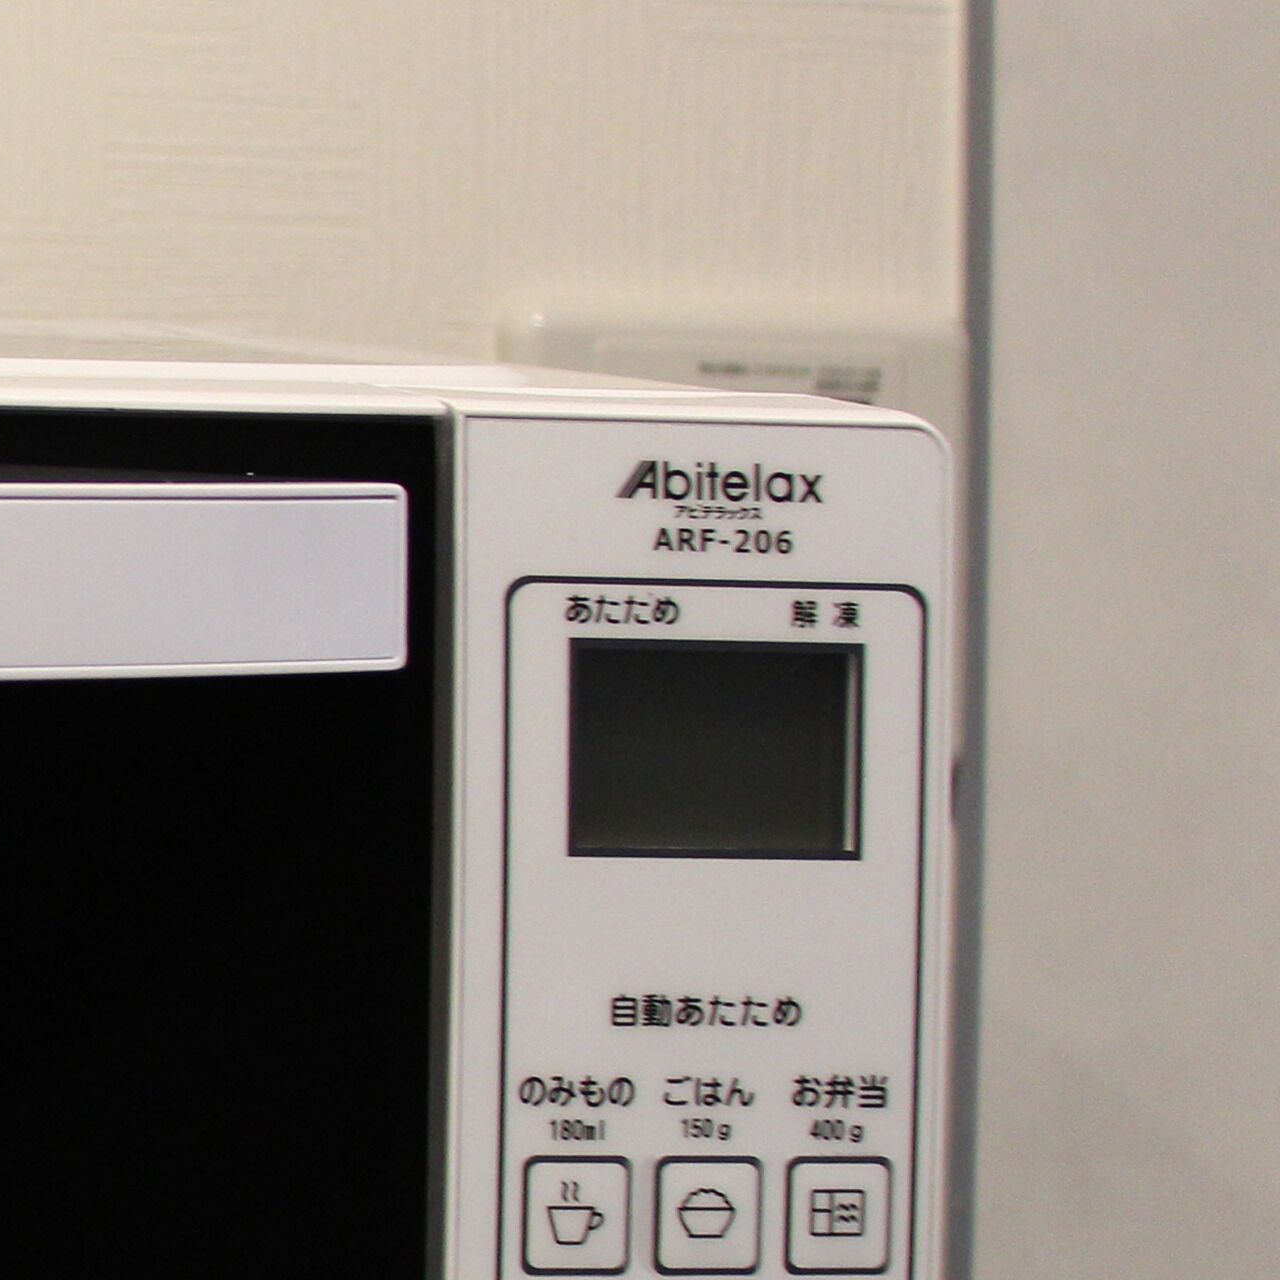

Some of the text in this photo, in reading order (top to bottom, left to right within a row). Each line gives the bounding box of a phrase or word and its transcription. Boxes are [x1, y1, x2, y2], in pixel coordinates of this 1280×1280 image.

[615, 459, 824, 504] Abitelax
[652, 527, 794, 555] ARF-206
[564, 594, 860, 629] あたため 解凍
[610, 993, 803, 1028] 自動あたため
[517, 1075, 636, 1109] のみもの
[662, 1075, 756, 1108] ごはん
[791, 1074, 889, 1110] お弁当
